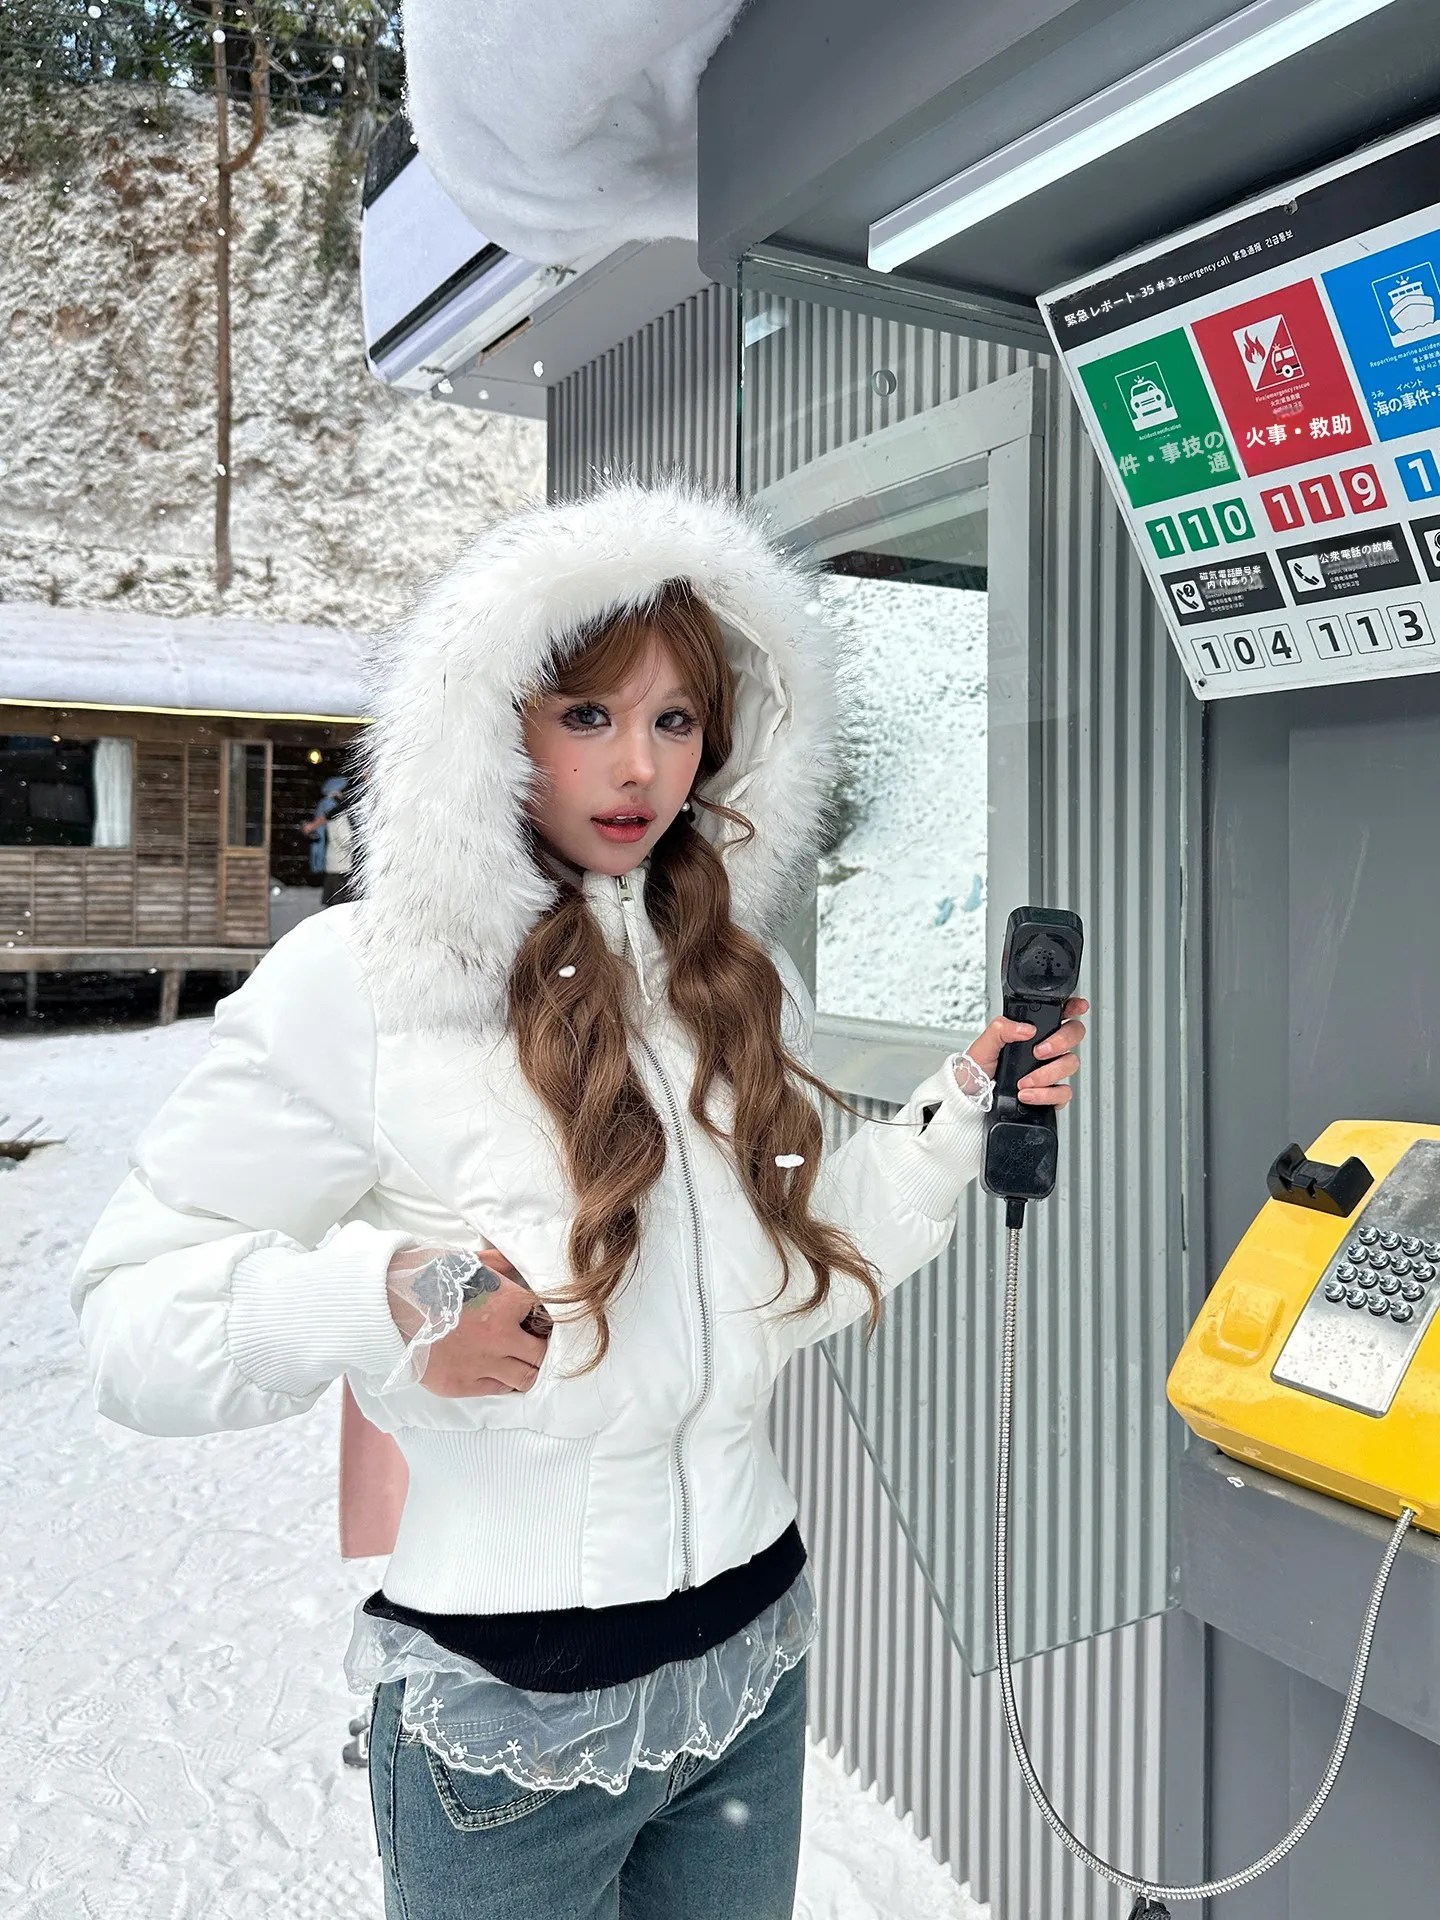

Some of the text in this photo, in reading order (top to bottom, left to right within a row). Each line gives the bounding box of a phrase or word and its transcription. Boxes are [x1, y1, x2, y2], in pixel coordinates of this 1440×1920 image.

[1064, 291, 1136, 327] 緊急レポート
[1177, 262, 1217, 284] Emergency
[1373, 384, 1440, 418] 海の事件・
[1396, 378, 1423, 392] イベント
[1246, 413, 1352, 448] 火事・救助
[1119, 431, 1224, 477] 件・事技の
[1207, 450, 1230, 474] 通
[1319, 539, 1394, 565] 公衆電話の故障
[1318, 609, 1424, 652] 113
[1201, 630, 1292, 669] 104
